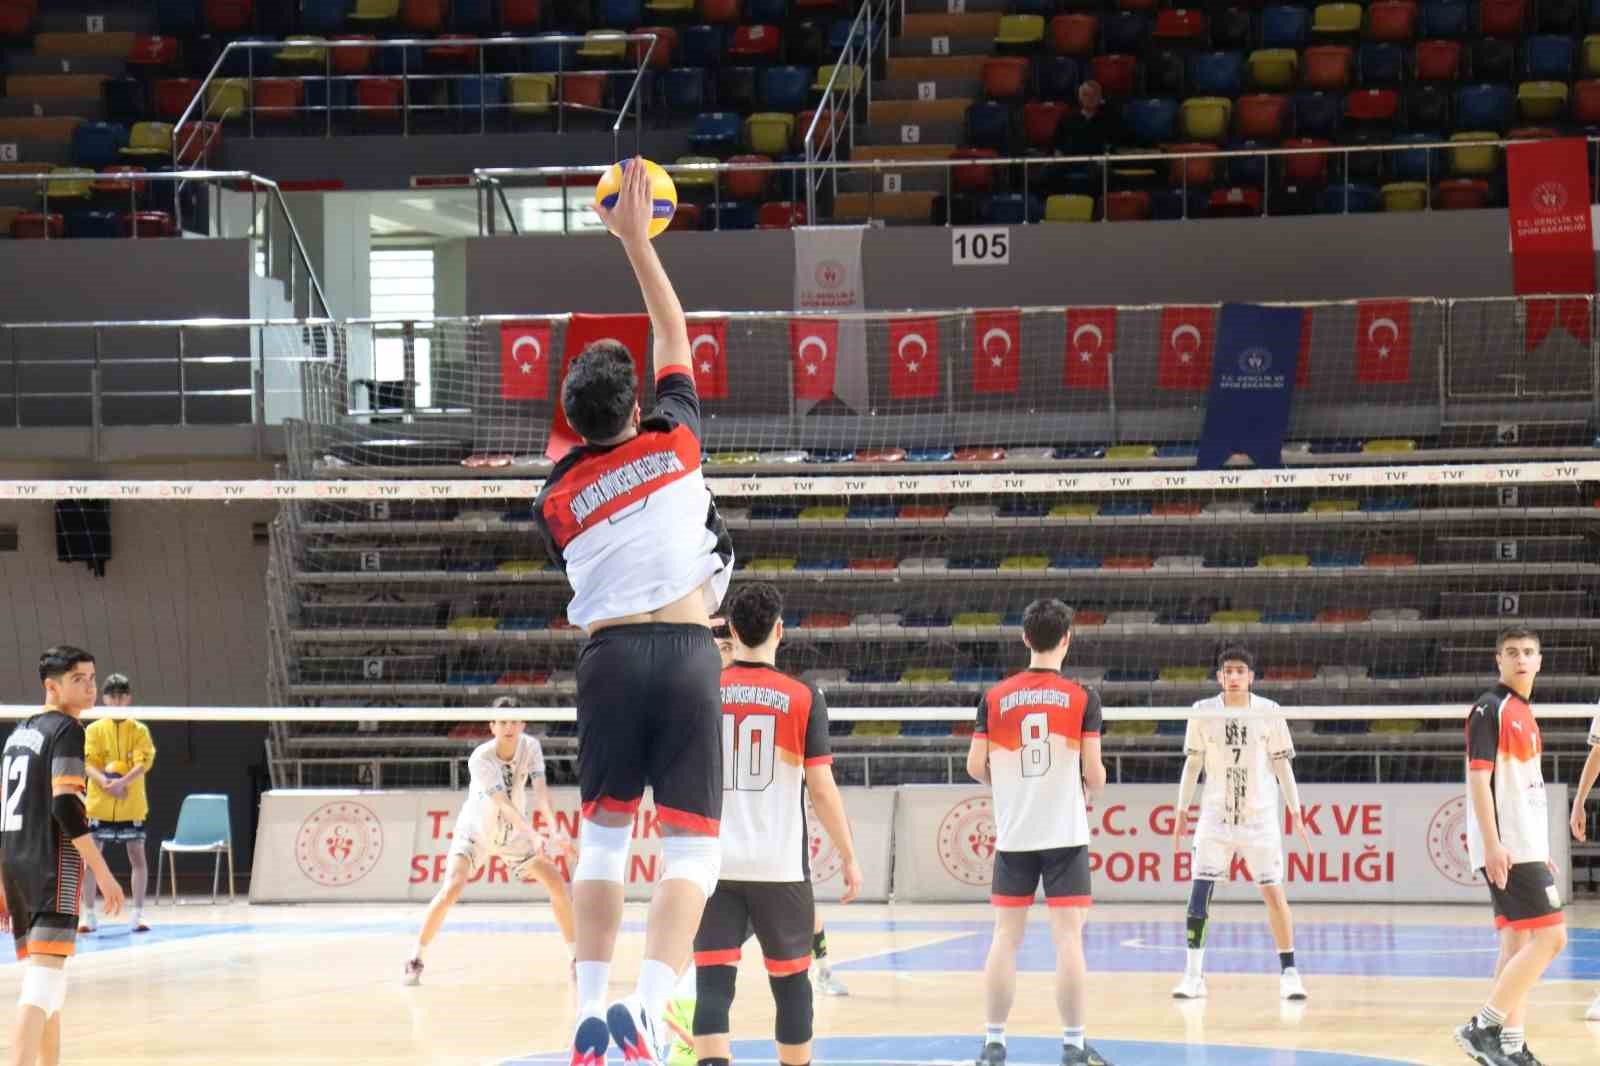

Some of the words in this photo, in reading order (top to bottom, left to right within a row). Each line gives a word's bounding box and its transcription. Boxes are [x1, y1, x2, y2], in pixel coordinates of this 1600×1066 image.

[955, 233, 1007, 259] 105
[16, 486, 37, 495] TVF
[69, 486, 89, 495] TVF
[121, 486, 141, 495] TVF
[171, 486, 193, 495] TVF
[225, 486, 245, 495] TVF
[275, 486, 297, 495] TVF
[328, 486, 347, 495] TVF
[377, 486, 399, 495] TVF
[431, 486, 451, 495] TVF
[481, 485, 501, 494] TVF
[740, 483, 761, 492] TVF
[793, 482, 814, 491] TVF
[845, 481, 867, 490] TVF
[898, 480, 919, 489] TVF
[951, 480, 972, 489] TVF
[1004, 480, 1025, 488] TVF
[1057, 479, 1079, 488] TVF
[1112, 478, 1133, 486] TVF
[1165, 477, 1187, 486] TVF
[1220, 476, 1242, 485] TVF
[1275, 474, 1297, 483] TVF
[1329, 473, 1352, 482] TVF
[1386, 472, 1408, 481] TVF
[1441, 471, 1464, 480] TVF
[1499, 469, 1521, 478] TVF
[1556, 468, 1579, 477] TVF
[721, 713, 776, 791] 10
[1021, 711, 1051, 778] 8
[1232, 748, 1241, 764] 7
[0, 754, 29, 832] 12
[1086, 804, 1137, 836] .C.
[1331, 804, 1382, 836] VE
[1088, 851, 1161, 883] POR
[1173, 844, 1394, 883] BKNLIĞI
